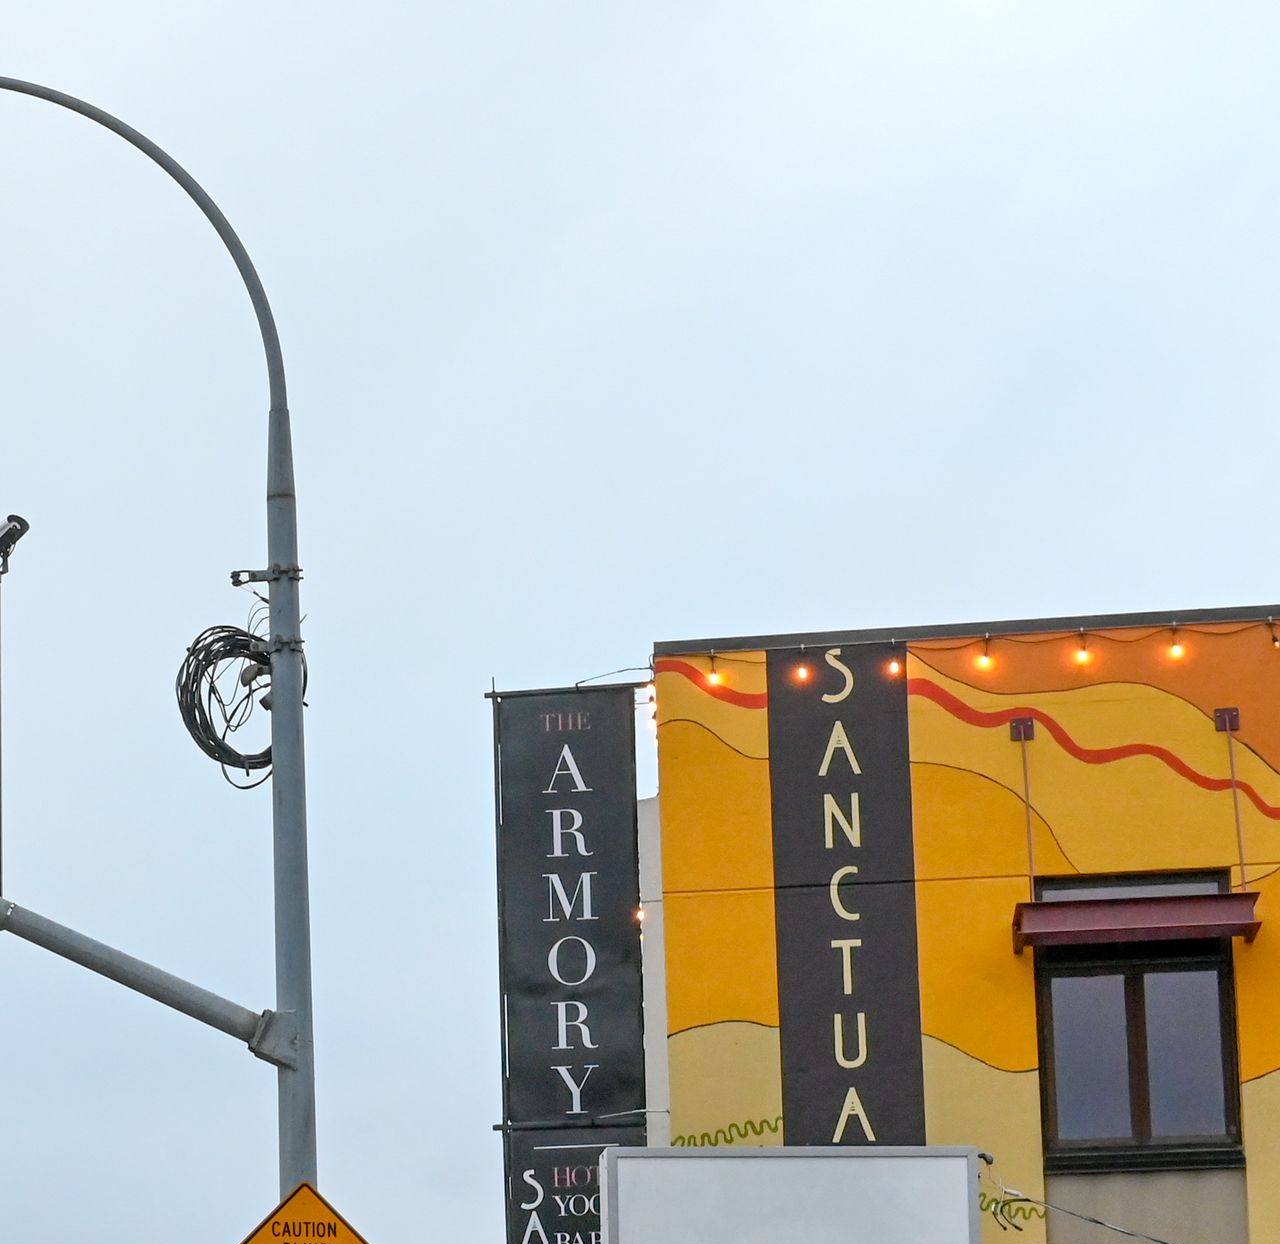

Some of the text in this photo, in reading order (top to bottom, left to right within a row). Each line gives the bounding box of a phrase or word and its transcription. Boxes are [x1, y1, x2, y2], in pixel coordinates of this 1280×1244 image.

[539, 711, 592, 732] THE
[541, 744, 600, 1117] ARMORY
[271, 1220, 337, 1238] CAUTION
